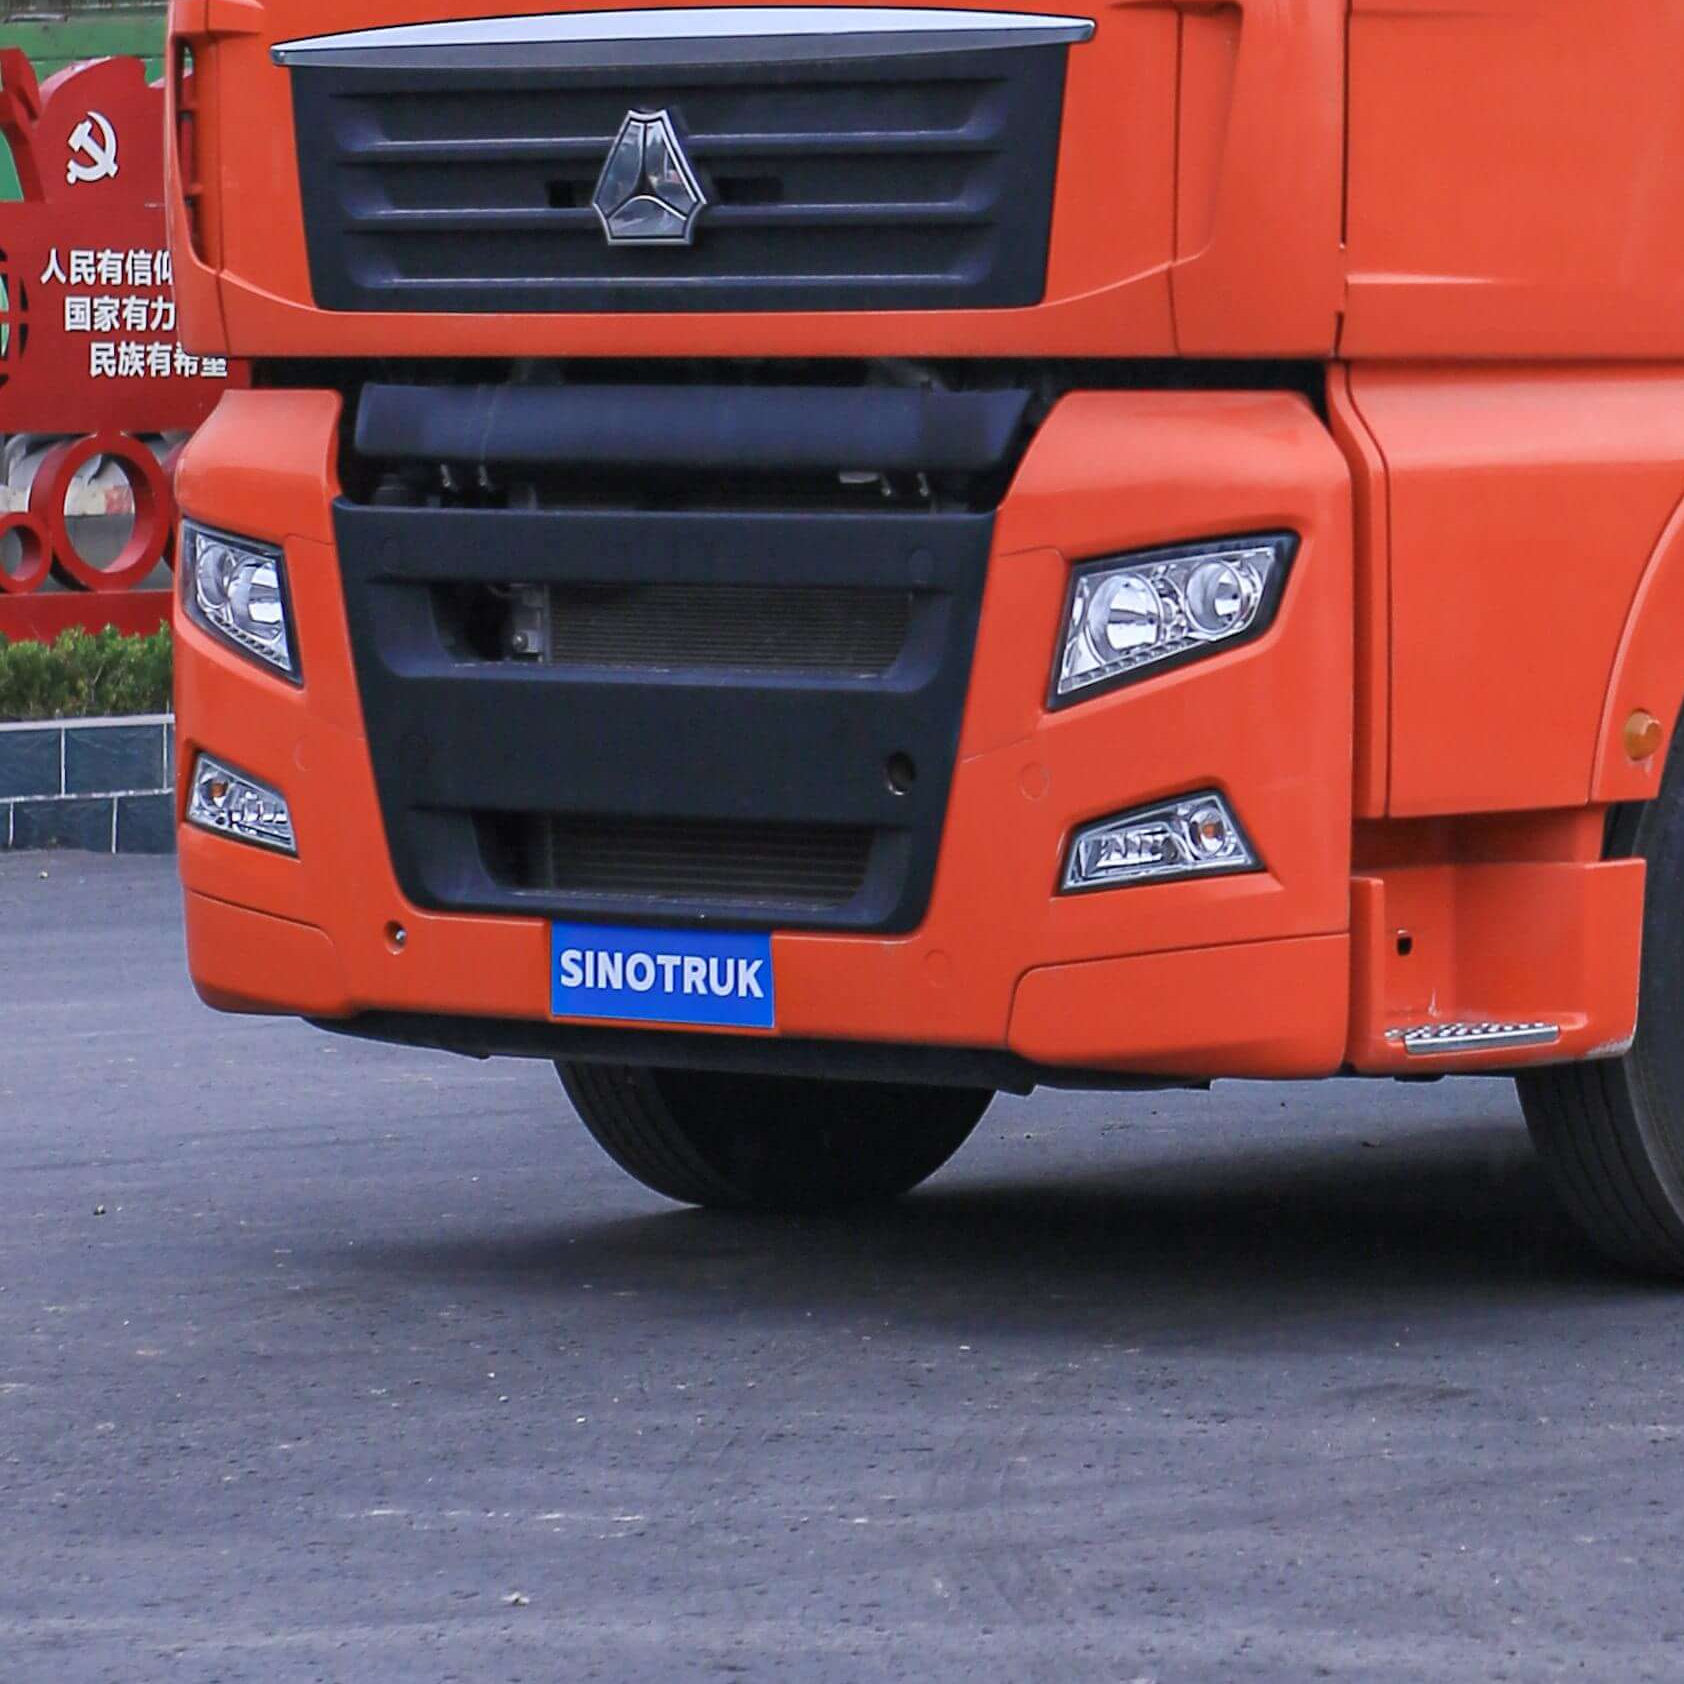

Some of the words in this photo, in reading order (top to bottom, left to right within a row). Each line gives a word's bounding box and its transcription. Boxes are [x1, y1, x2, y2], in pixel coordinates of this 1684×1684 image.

[65, 296, 179, 333] 国家有力
[560, 948, 765, 999] SINOTRUK
